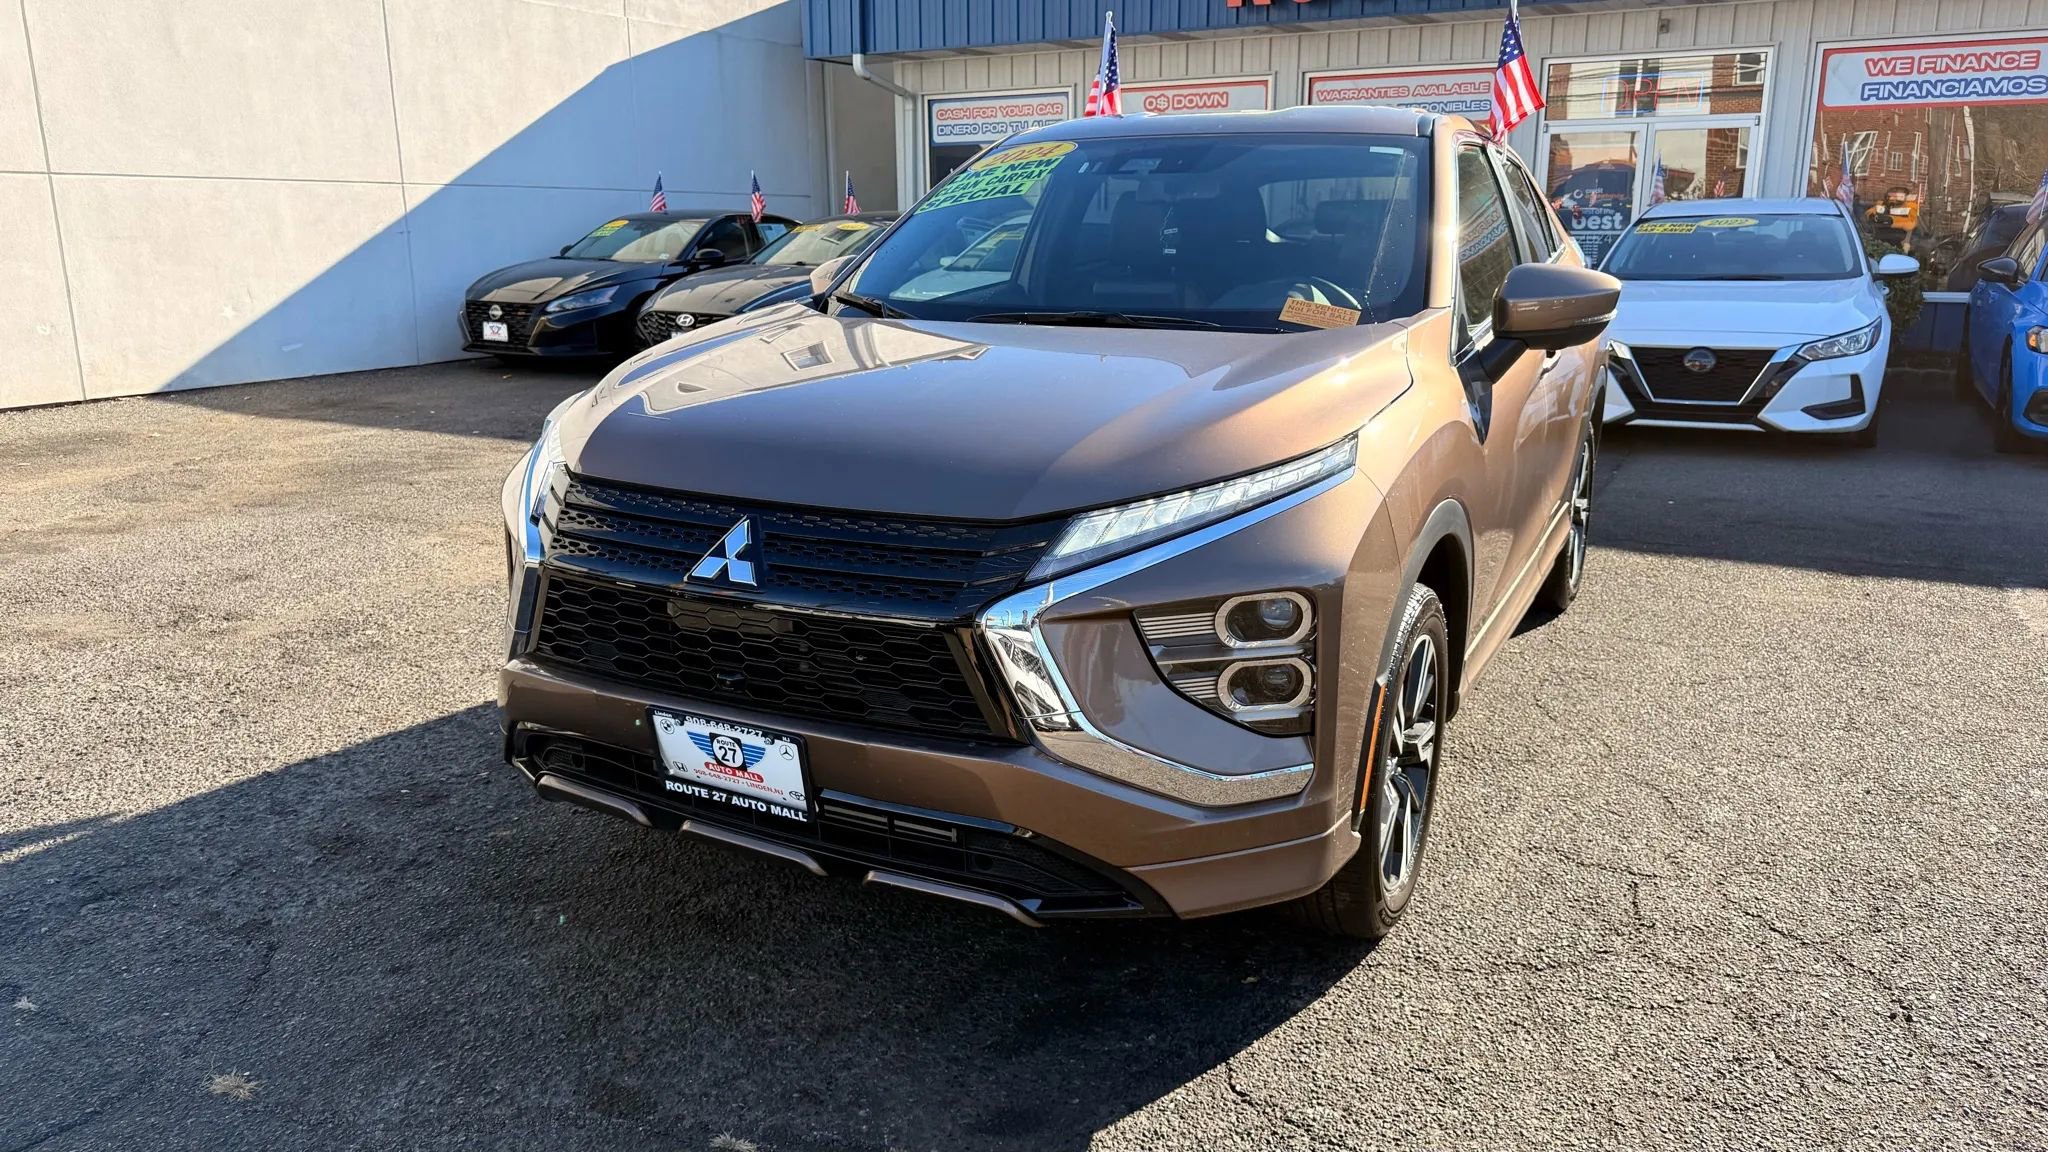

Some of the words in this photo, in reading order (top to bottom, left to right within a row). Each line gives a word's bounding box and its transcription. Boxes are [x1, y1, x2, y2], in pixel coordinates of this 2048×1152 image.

[1866, 56, 1914, 77] WE
[1917, 50, 2041, 74] FINANCE
[1317, 86, 1409, 101] WARRANTIES
[1411, 81, 1490, 96] AVAILABLE
[1609, 77, 1700, 109] OPEN
[1861, 75, 2048, 101] FINANCIAMOS
[1172, 91, 1229, 110] DOWN
[1397, 99, 1491, 113] PONIBLES
[937, 109, 970, 120] CASH
[972, 107, 997, 119] FOR
[1000, 105, 1034, 117] YOUR
[1037, 103, 1063, 115] CAR
[937, 124, 979, 136] DINERO
[981, 122, 1007, 134] POR
[1009, 121, 1029, 133] TU
[985, 144, 1064, 167] 2024
[949, 166, 999, 185] LIKE
[1002, 158, 1060, 173] NEW
[935, 179, 984, 198] CLEAN
[985, 168, 1050, 186] CARFAX
[920, 183, 1025, 211] SPECIAL
[1572, 211, 1623, 230] best
[1291, 300, 1312, 308] THIS
[1315, 304, 1357, 316] VEHICLE
[1306, 308, 1327, 317] FOR
[1329, 312, 1355, 321] SALE
[716, 738, 736, 748] ROUTE
[719, 746, 737, 764] 27
[708, 764, 733, 775] AUTO
[735, 770, 761, 782] MALL
[665, 780, 709, 798] ROUTE
[712, 791, 727, 802] 27
[731, 795, 767, 812] AUTO
[770, 805, 807, 822] MALL
